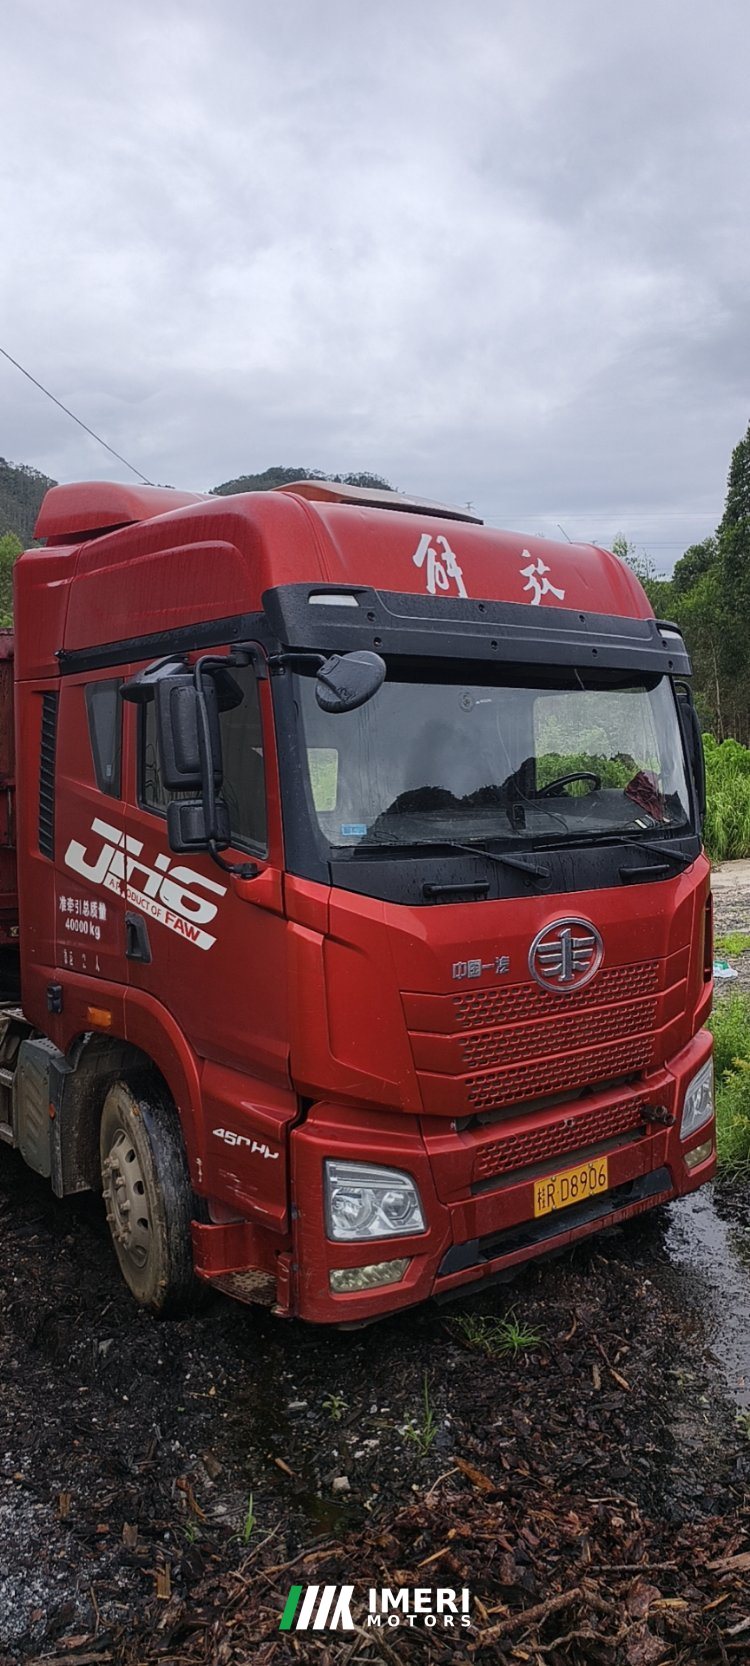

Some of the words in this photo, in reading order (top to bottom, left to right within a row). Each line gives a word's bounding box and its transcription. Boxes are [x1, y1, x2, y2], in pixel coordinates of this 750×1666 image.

[115, 882, 150, 910] PODUCT
[151, 905, 162, 917] OF
[164, 911, 201, 942] FAW
[89, 920, 101, 940] kg
[452, 956, 510, 979] 中国一汽
